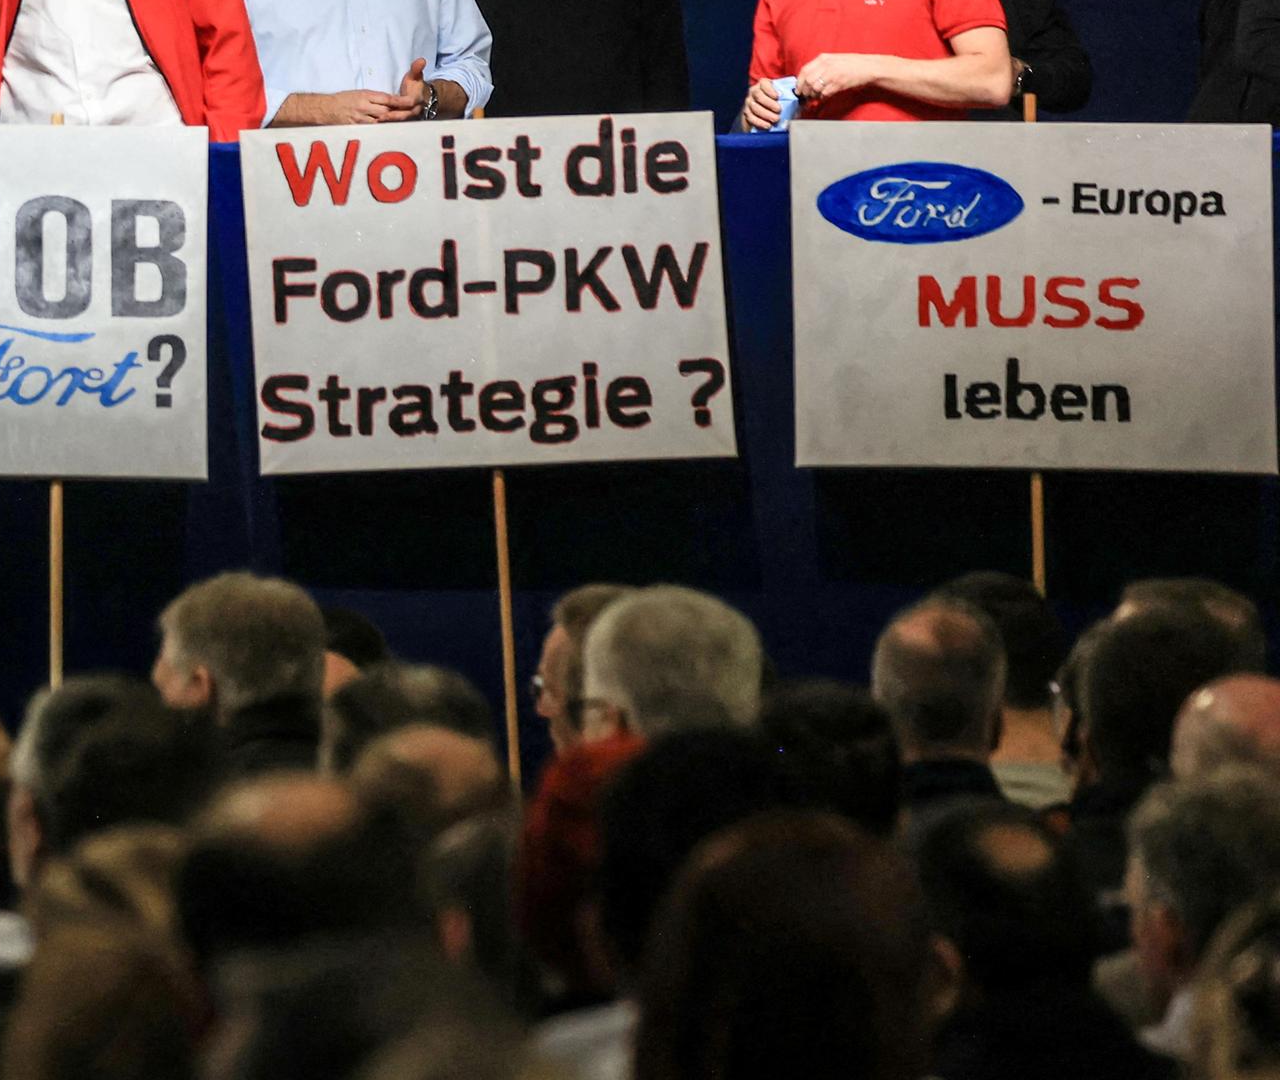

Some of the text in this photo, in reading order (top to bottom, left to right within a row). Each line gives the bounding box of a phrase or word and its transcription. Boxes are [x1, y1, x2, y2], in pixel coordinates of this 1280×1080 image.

[275, 115, 690, 207] Wo ist die
[857, 177, 982, 229] Ford
[272, 239, 709, 324] Ford-PKW
[917, 274, 1145, 331] MUSS
[260, 362, 653, 445] Strategie
[944, 358, 1132, 422] leben
